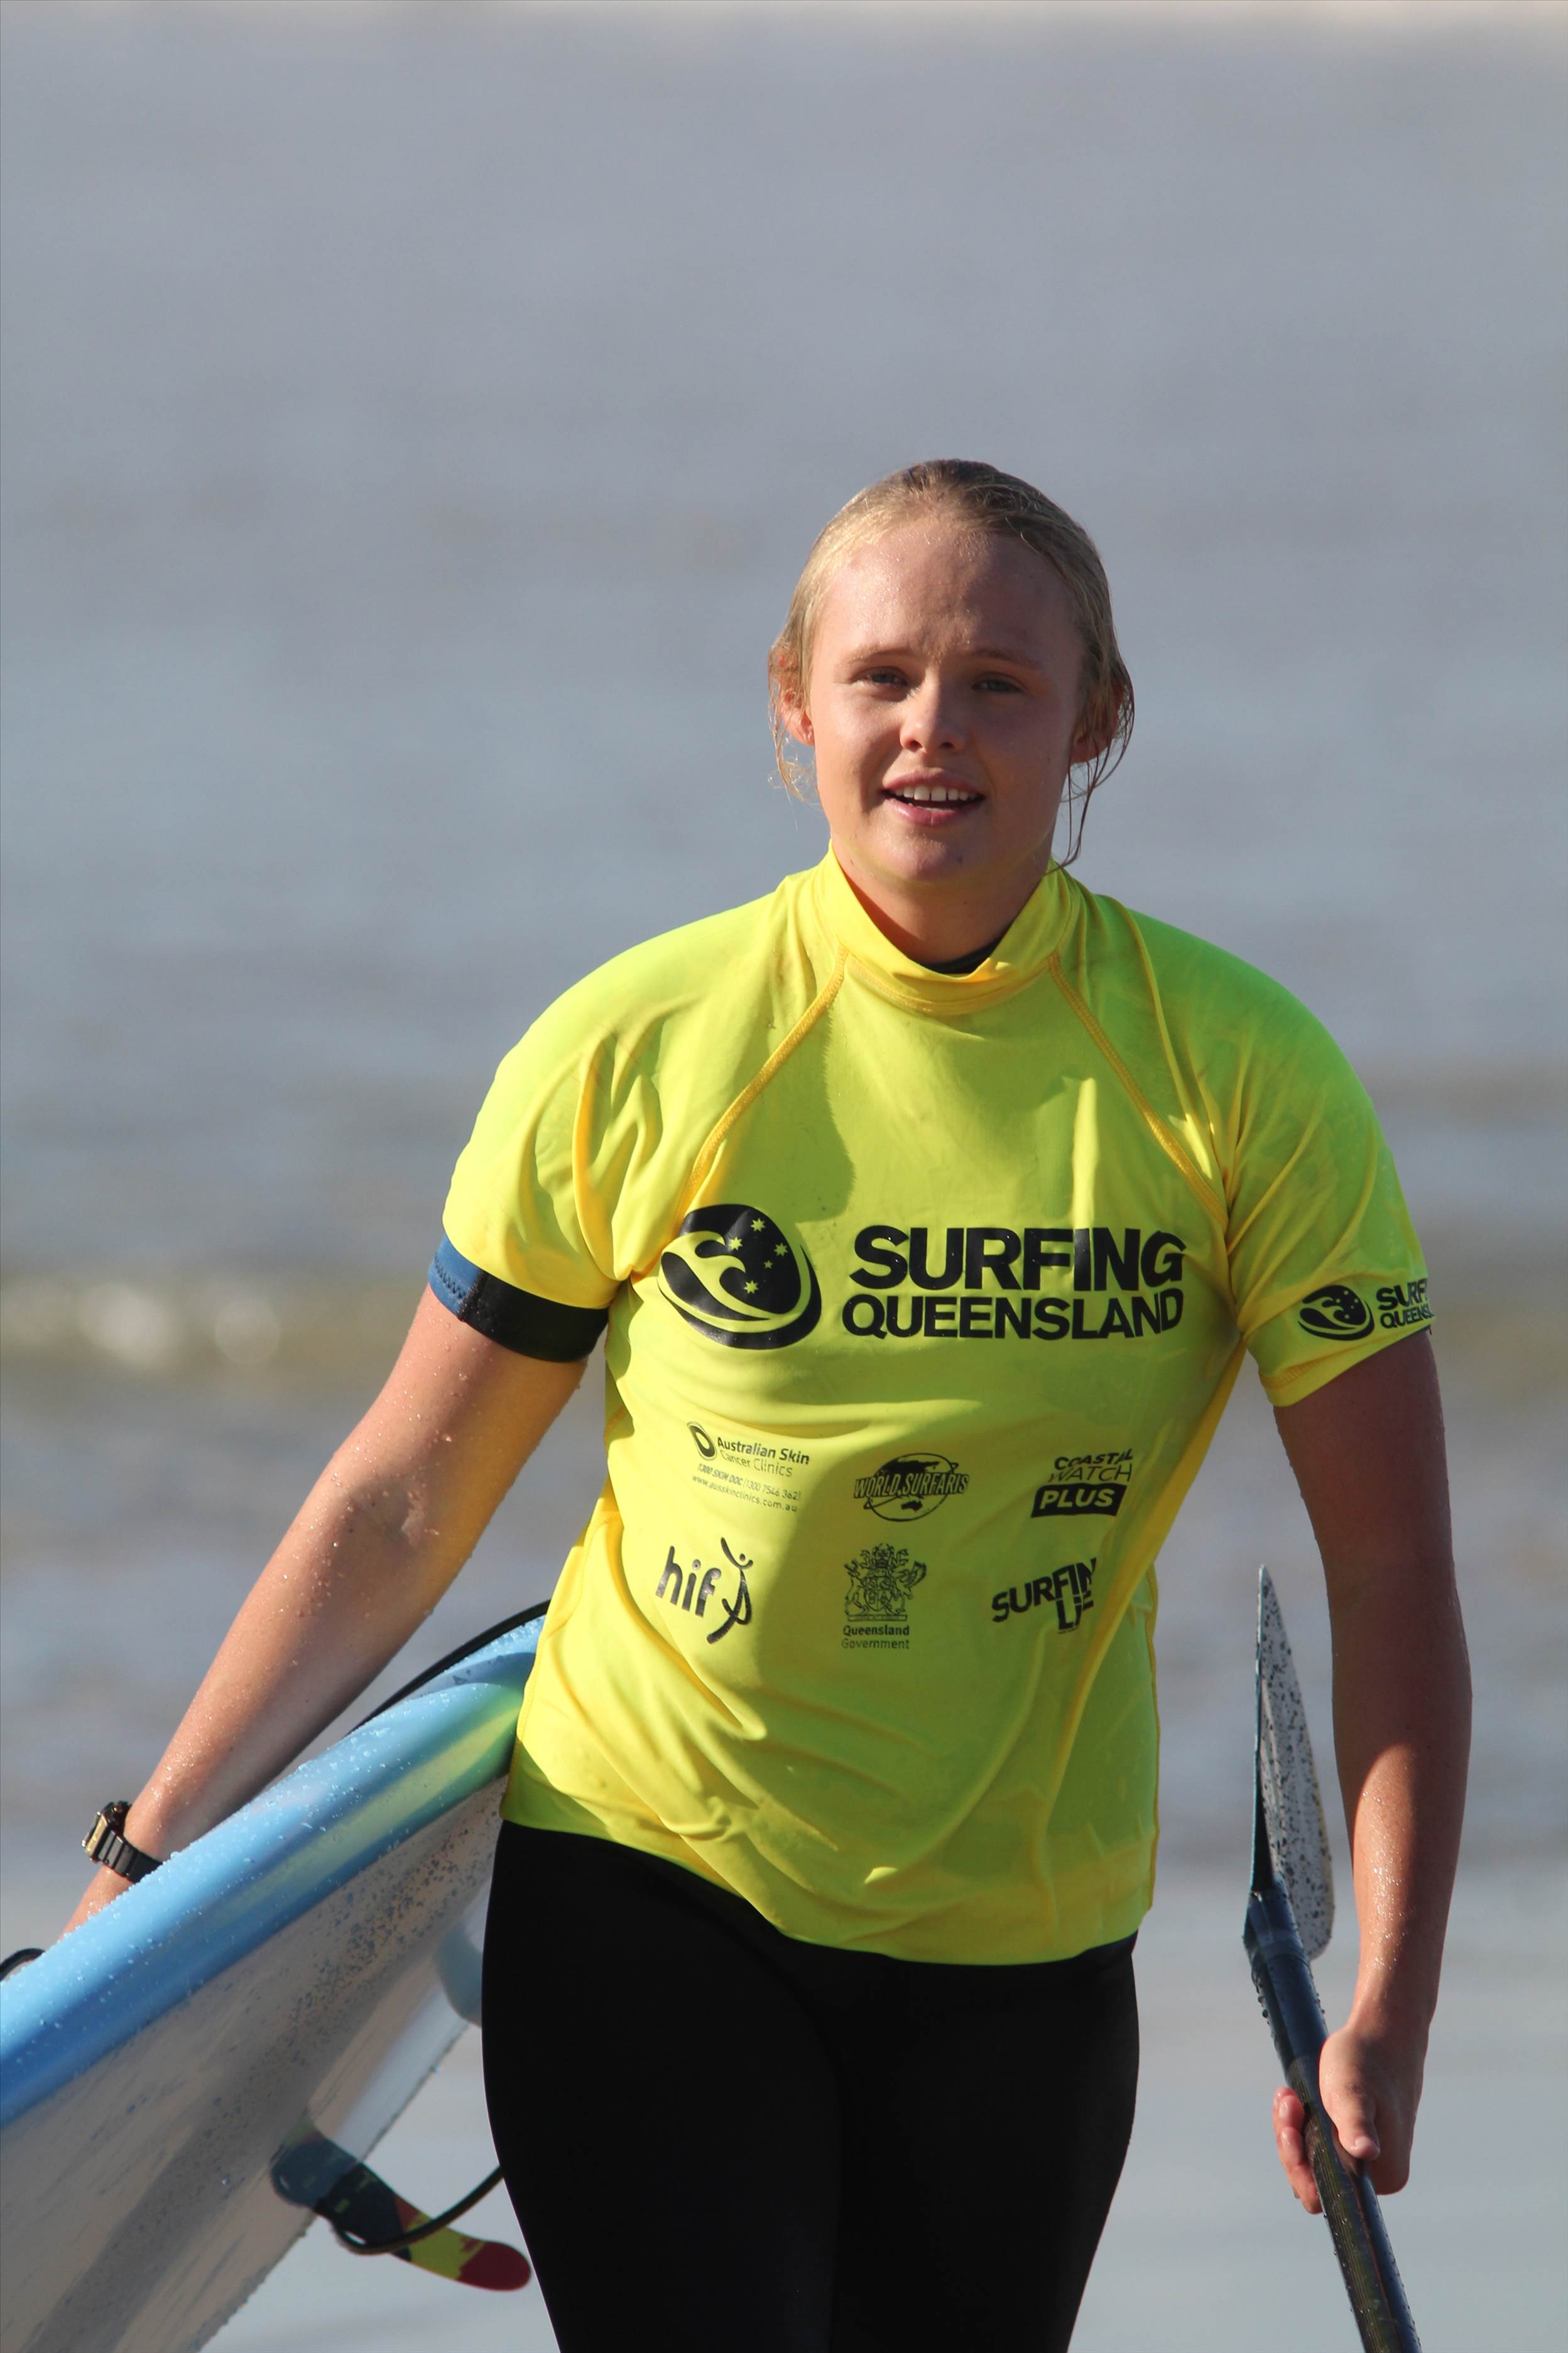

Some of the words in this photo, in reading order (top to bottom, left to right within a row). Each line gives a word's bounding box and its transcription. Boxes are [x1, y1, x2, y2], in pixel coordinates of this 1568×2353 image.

[849, 1225, 1186, 1291] SURFING
[1376, 1278, 1428, 1310] SURF
[842, 1288, 1184, 1340] QUEENSLAND
[717, 1437, 776, 1458] Australian
[779, 1448, 810, 1465] Skin
[720, 1450, 751, 1468] Cancer
[754, 1458, 793, 1477] Clinics
[1040, 1488, 1116, 1510] PLUS
[655, 1546, 722, 1618] hif
[842, 1637, 910, 1649] Government
[843, 1624, 910, 1636] Queensland
